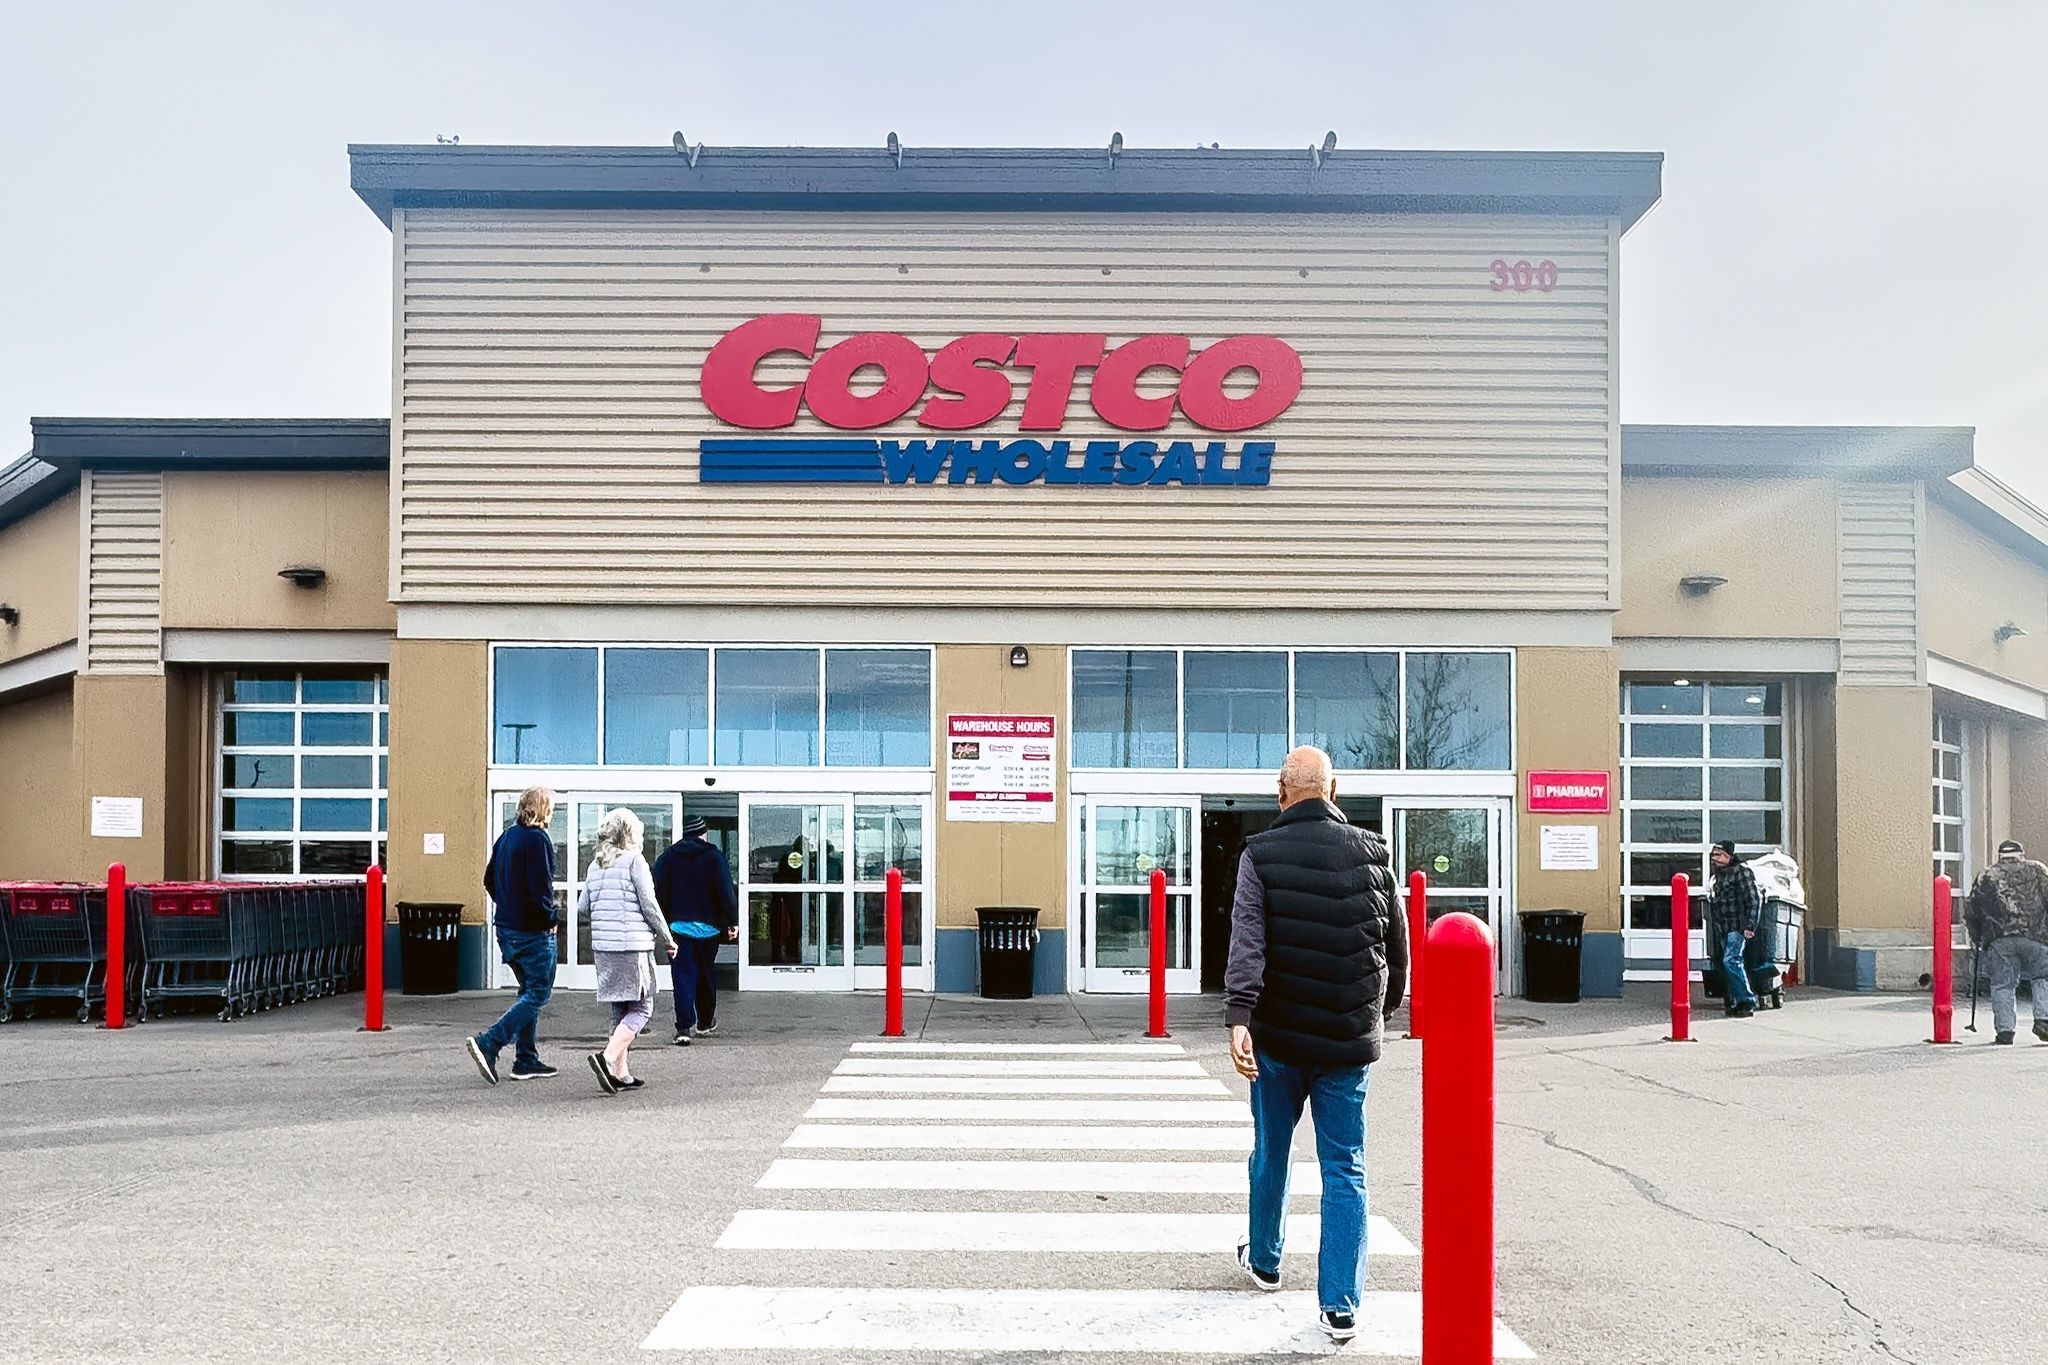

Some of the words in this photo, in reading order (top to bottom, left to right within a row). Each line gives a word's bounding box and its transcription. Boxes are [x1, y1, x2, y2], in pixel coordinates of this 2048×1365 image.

[1489, 259, 1558, 292] 300
[700, 313, 1303, 431] COSTCO
[879, 440, 1275, 486] WHOLESALE
[952, 720, 1014, 732] WAREHOUSE
[1016, 721, 1051, 733] HOURS
[1546, 785, 1604, 798] PHARMACY
